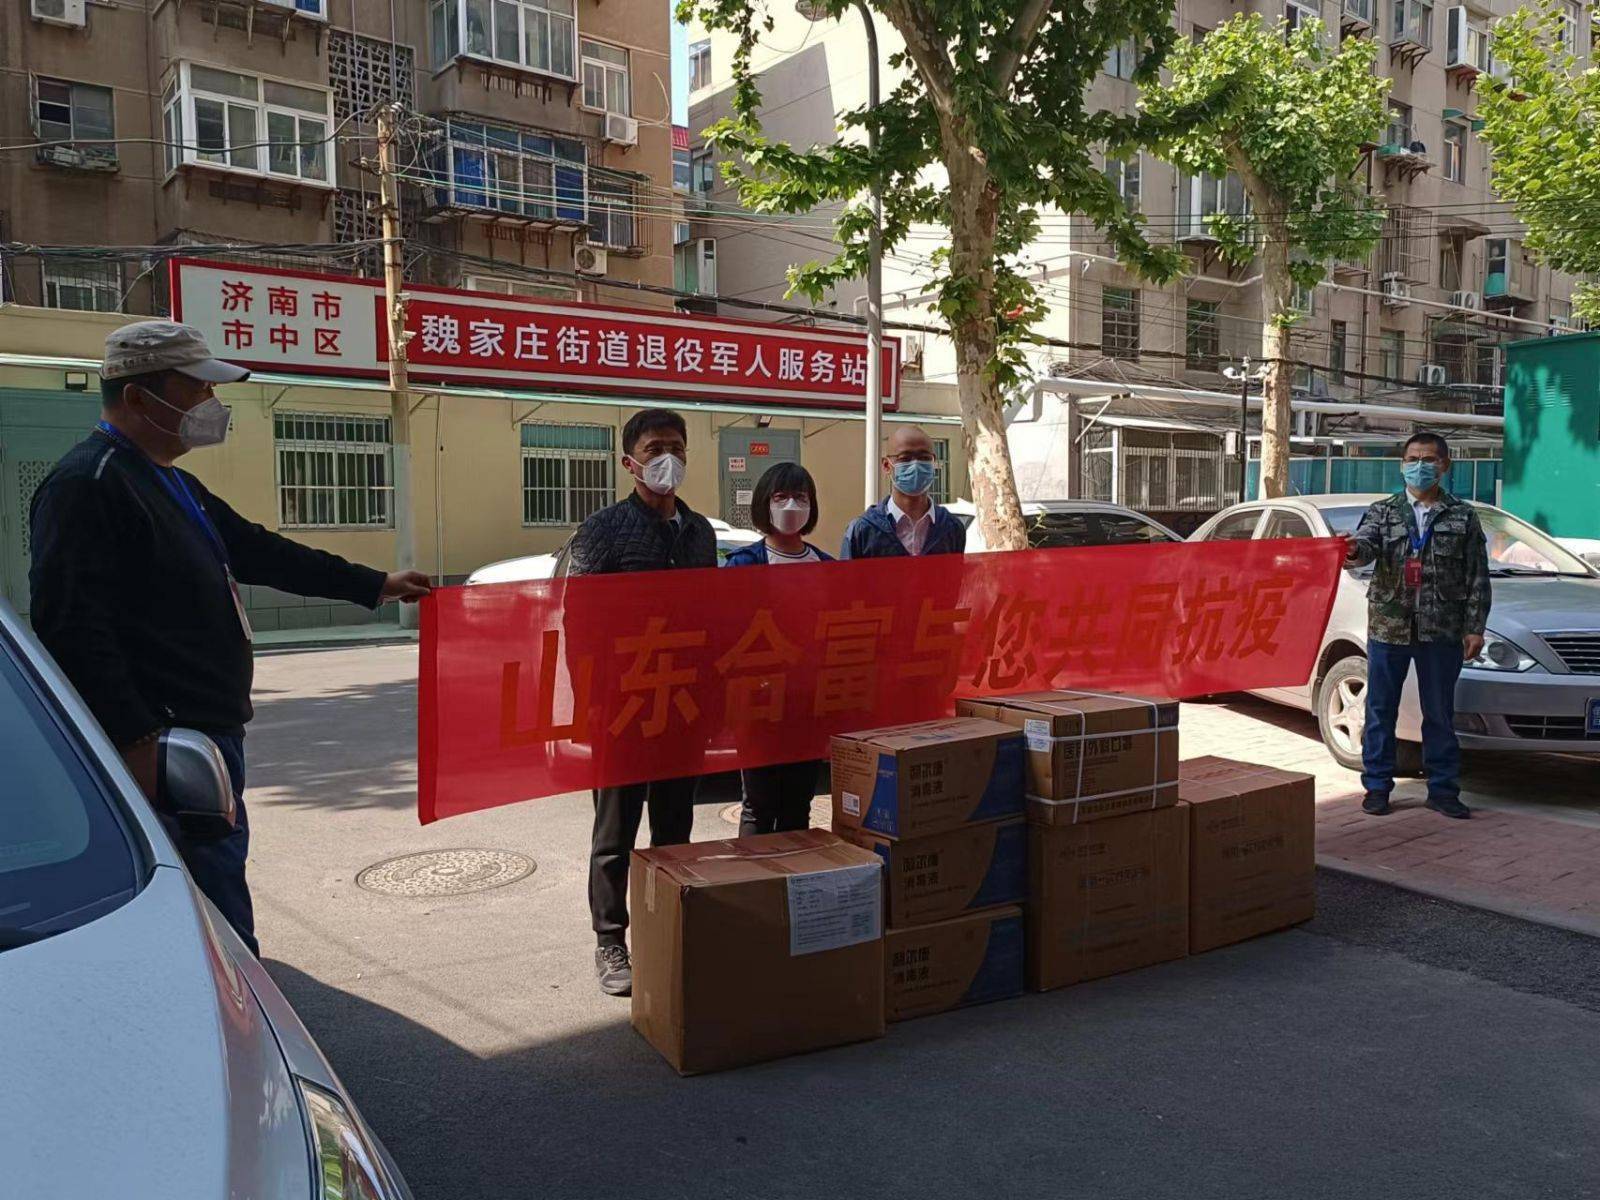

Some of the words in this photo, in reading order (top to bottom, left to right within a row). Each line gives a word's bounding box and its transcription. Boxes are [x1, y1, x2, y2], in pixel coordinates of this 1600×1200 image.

[221, 279, 342, 322] 济南市
[221, 319, 342, 357] 市中区
[421, 313, 867, 386] 魏家庄街道退役军人服务站
[498, 576, 1295, 750] 山东合富与您共同抗疫
